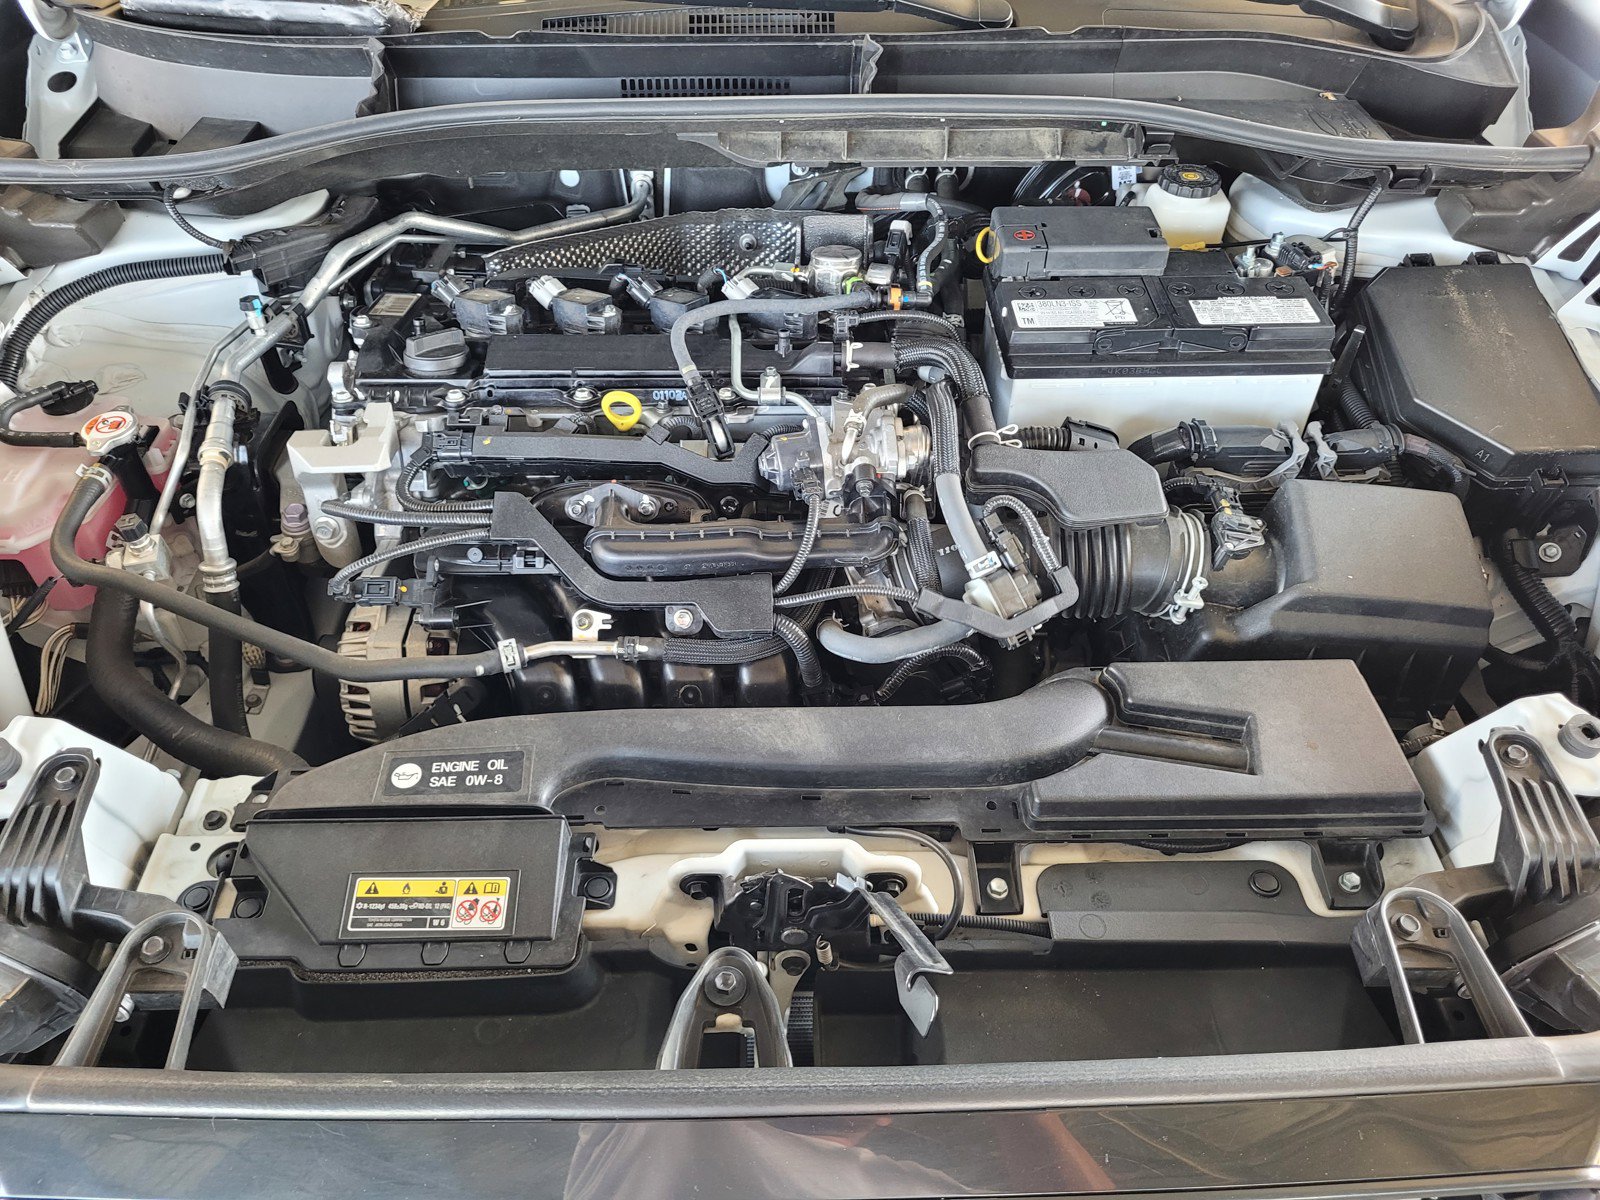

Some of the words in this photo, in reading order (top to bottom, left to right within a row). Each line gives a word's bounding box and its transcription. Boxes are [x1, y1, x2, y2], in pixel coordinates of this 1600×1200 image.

[1022, 317, 1035, 325] TM
[1474, 449, 1491, 463] A1
[431, 760, 480, 773] ENGINE
[487, 758, 509, 771] OIL
[429, 775, 457, 788] SAE
[465, 774, 504, 787] 0W-8
